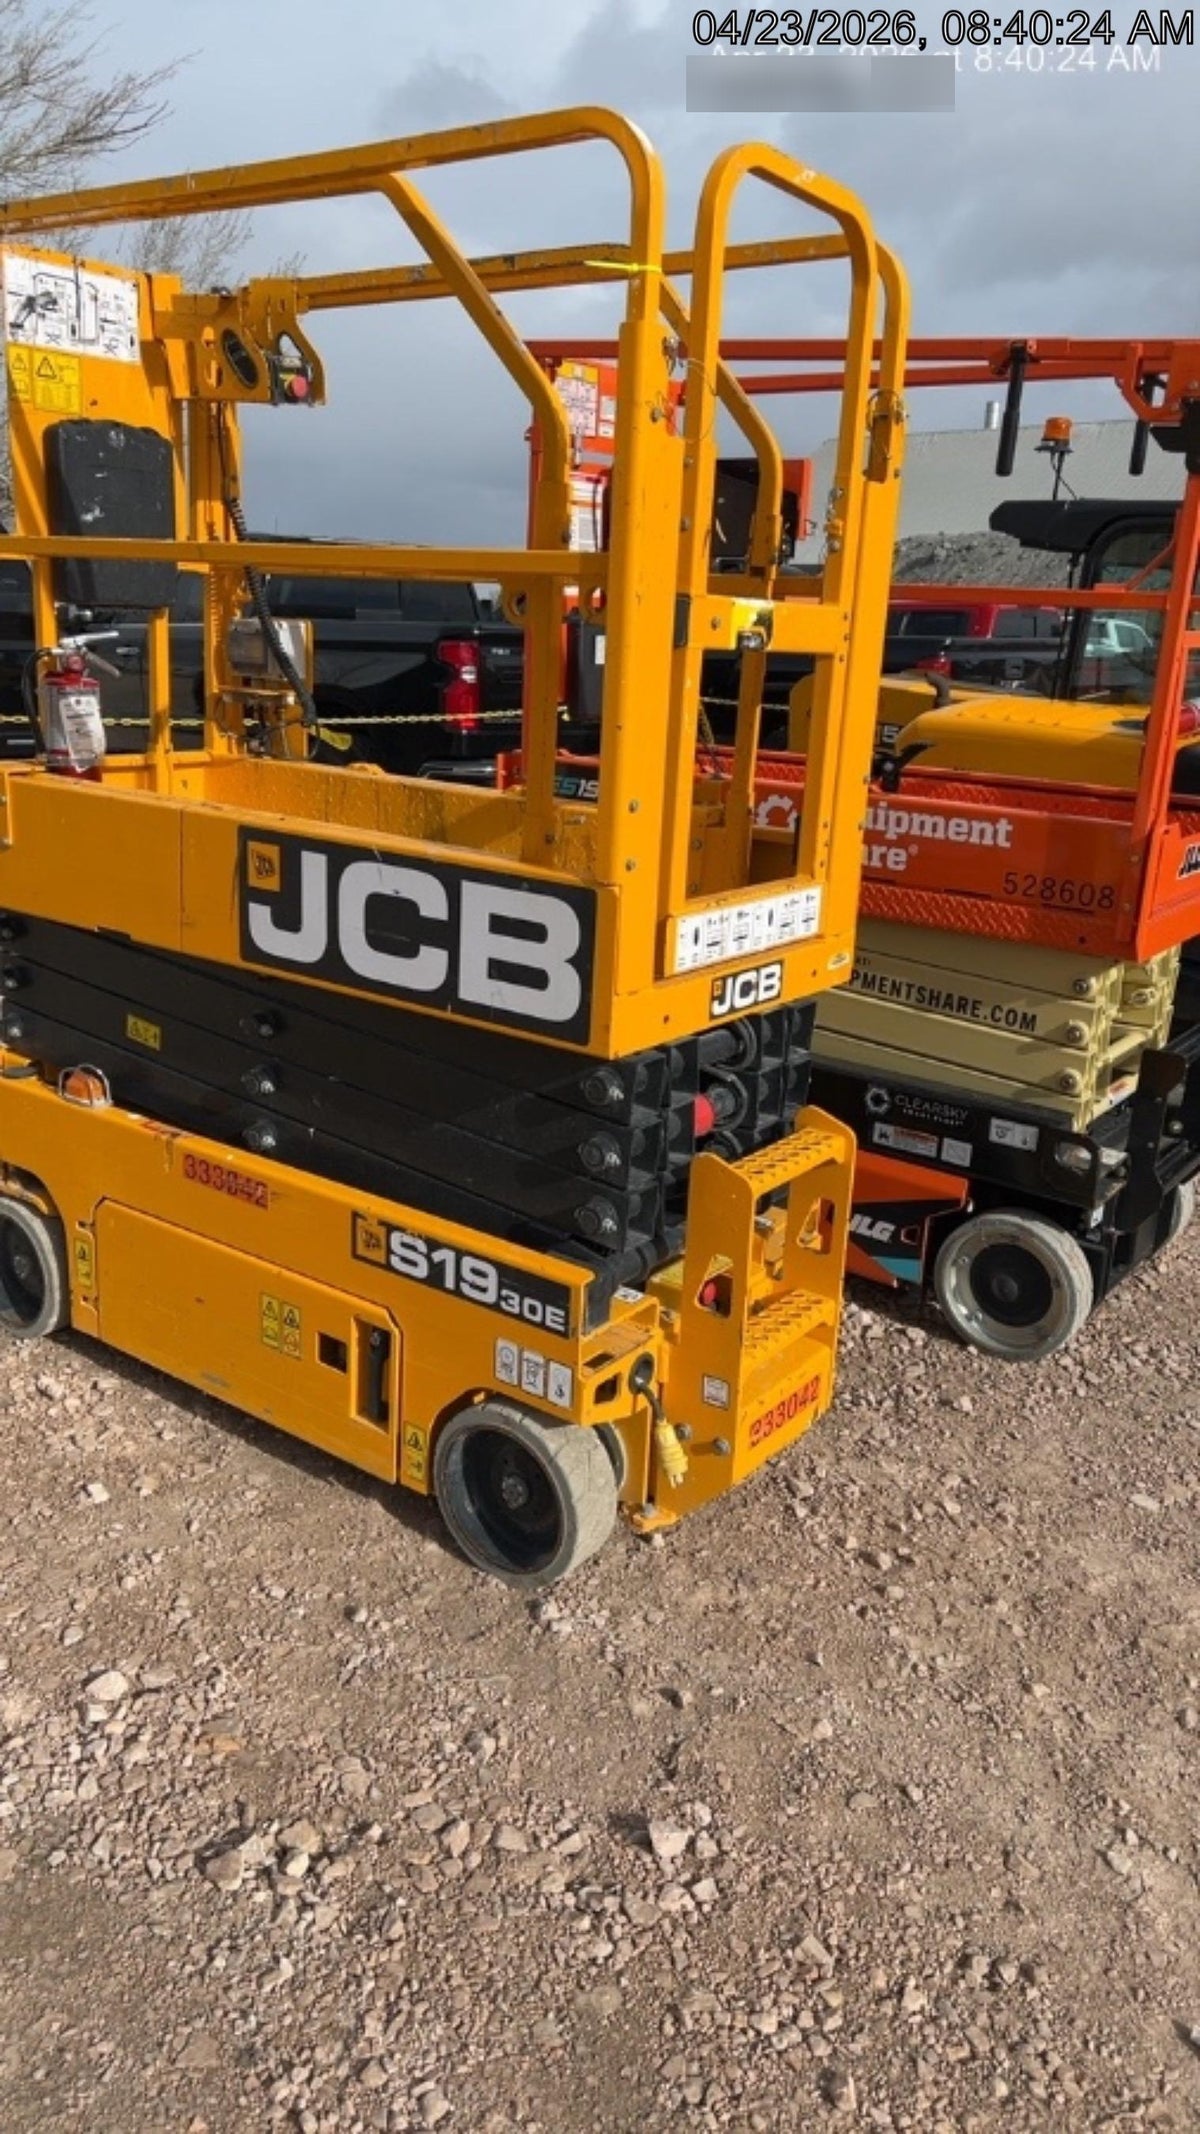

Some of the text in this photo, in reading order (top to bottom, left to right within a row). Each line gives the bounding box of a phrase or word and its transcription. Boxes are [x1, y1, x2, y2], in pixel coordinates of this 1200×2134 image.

[1002, 871, 1115, 910] 528608
[248, 849, 582, 1023] JCB
[711, 963, 782, 1016] JCB
[389, 1230, 566, 1332] S19 30E
